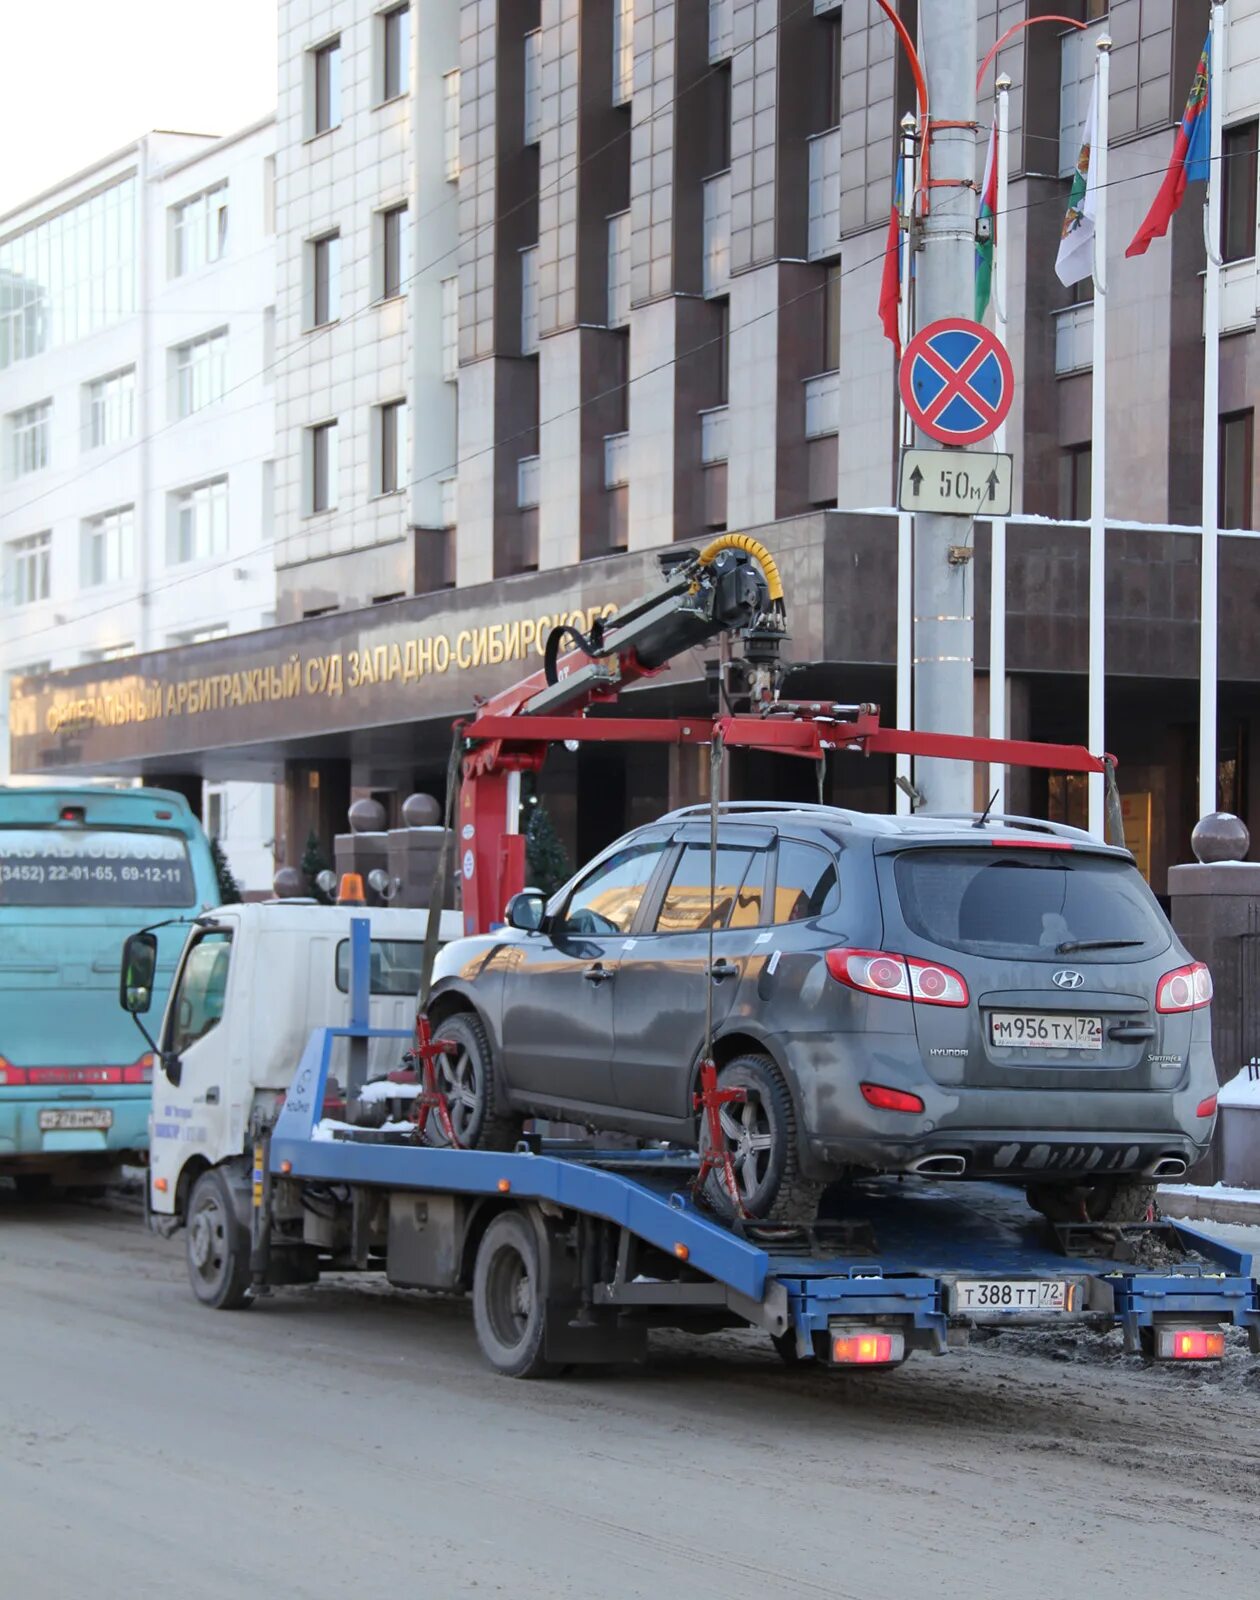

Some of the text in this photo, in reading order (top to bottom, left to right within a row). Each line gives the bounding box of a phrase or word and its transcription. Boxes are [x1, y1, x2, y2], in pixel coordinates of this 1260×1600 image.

[166, 653, 300, 716] АРБИТРАЖНЫЙ
[305, 653, 344, 697] СУД
[121, 867, 181, 882] 69-12-11
[930, 1048, 969, 1057] HYUNDAI
